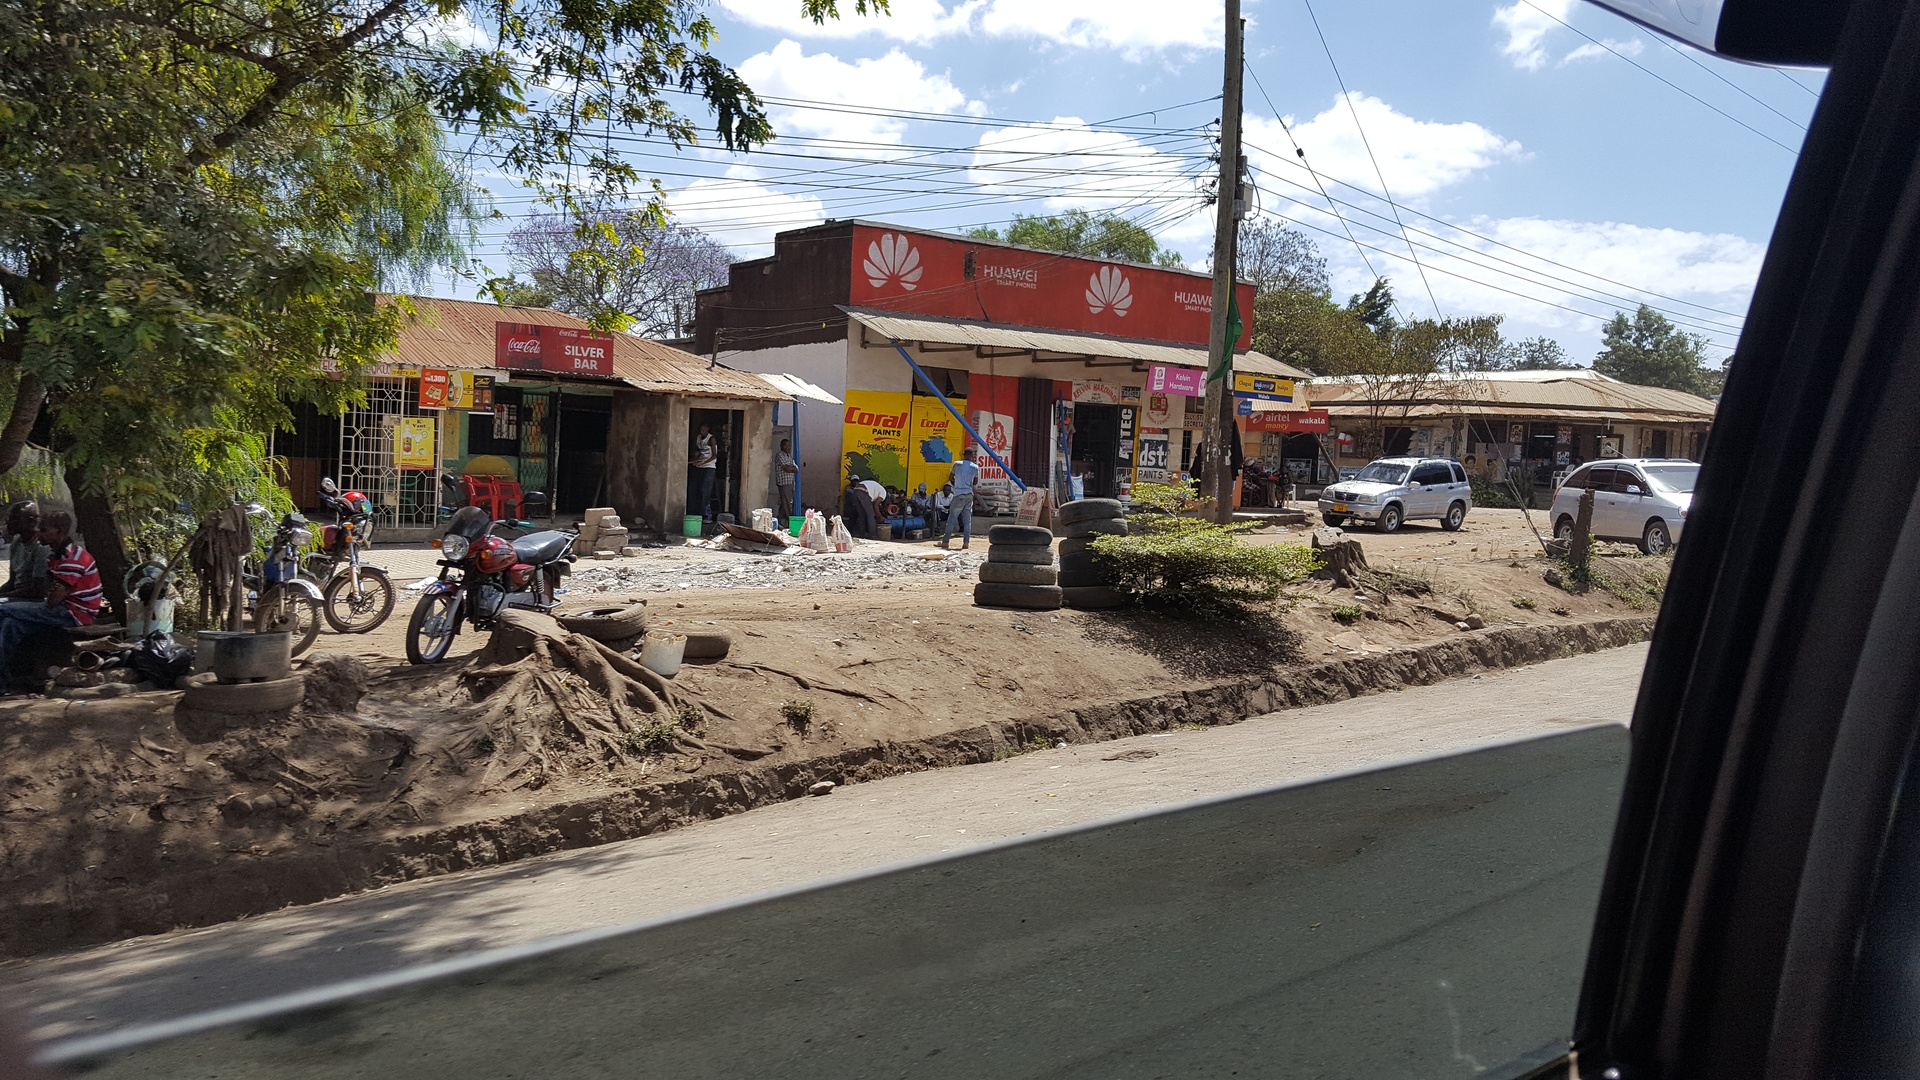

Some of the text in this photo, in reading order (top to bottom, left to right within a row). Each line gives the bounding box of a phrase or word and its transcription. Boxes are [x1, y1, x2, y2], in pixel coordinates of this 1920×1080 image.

[983, 264, 1038, 282] HUAWEI
[996, 279, 1037, 290] SMART PHONES
[1174, 291, 1213, 307] HUAWE
[1184, 304, 1200, 312] SMART
[508, 337, 541, 354] Coca-Cola
[564, 344, 605, 359] SILVER
[574, 358, 598, 370] BAR
[1175, 373, 1191, 382] Kelvin
[1168, 382, 1194, 392] Hardware
[844, 406, 909, 430] Coral
[1265, 412, 1290, 423] airtel
[1298, 416, 1326, 425] wakala
[920, 418, 950, 429] Coral
[1265, 423, 1290, 431] money
[872, 428, 902, 438] PAINTS
[857, 440, 881, 451] Decorate
[980, 468, 1007, 480] IMARA
[1138, 469, 1164, 480] PAINTS
